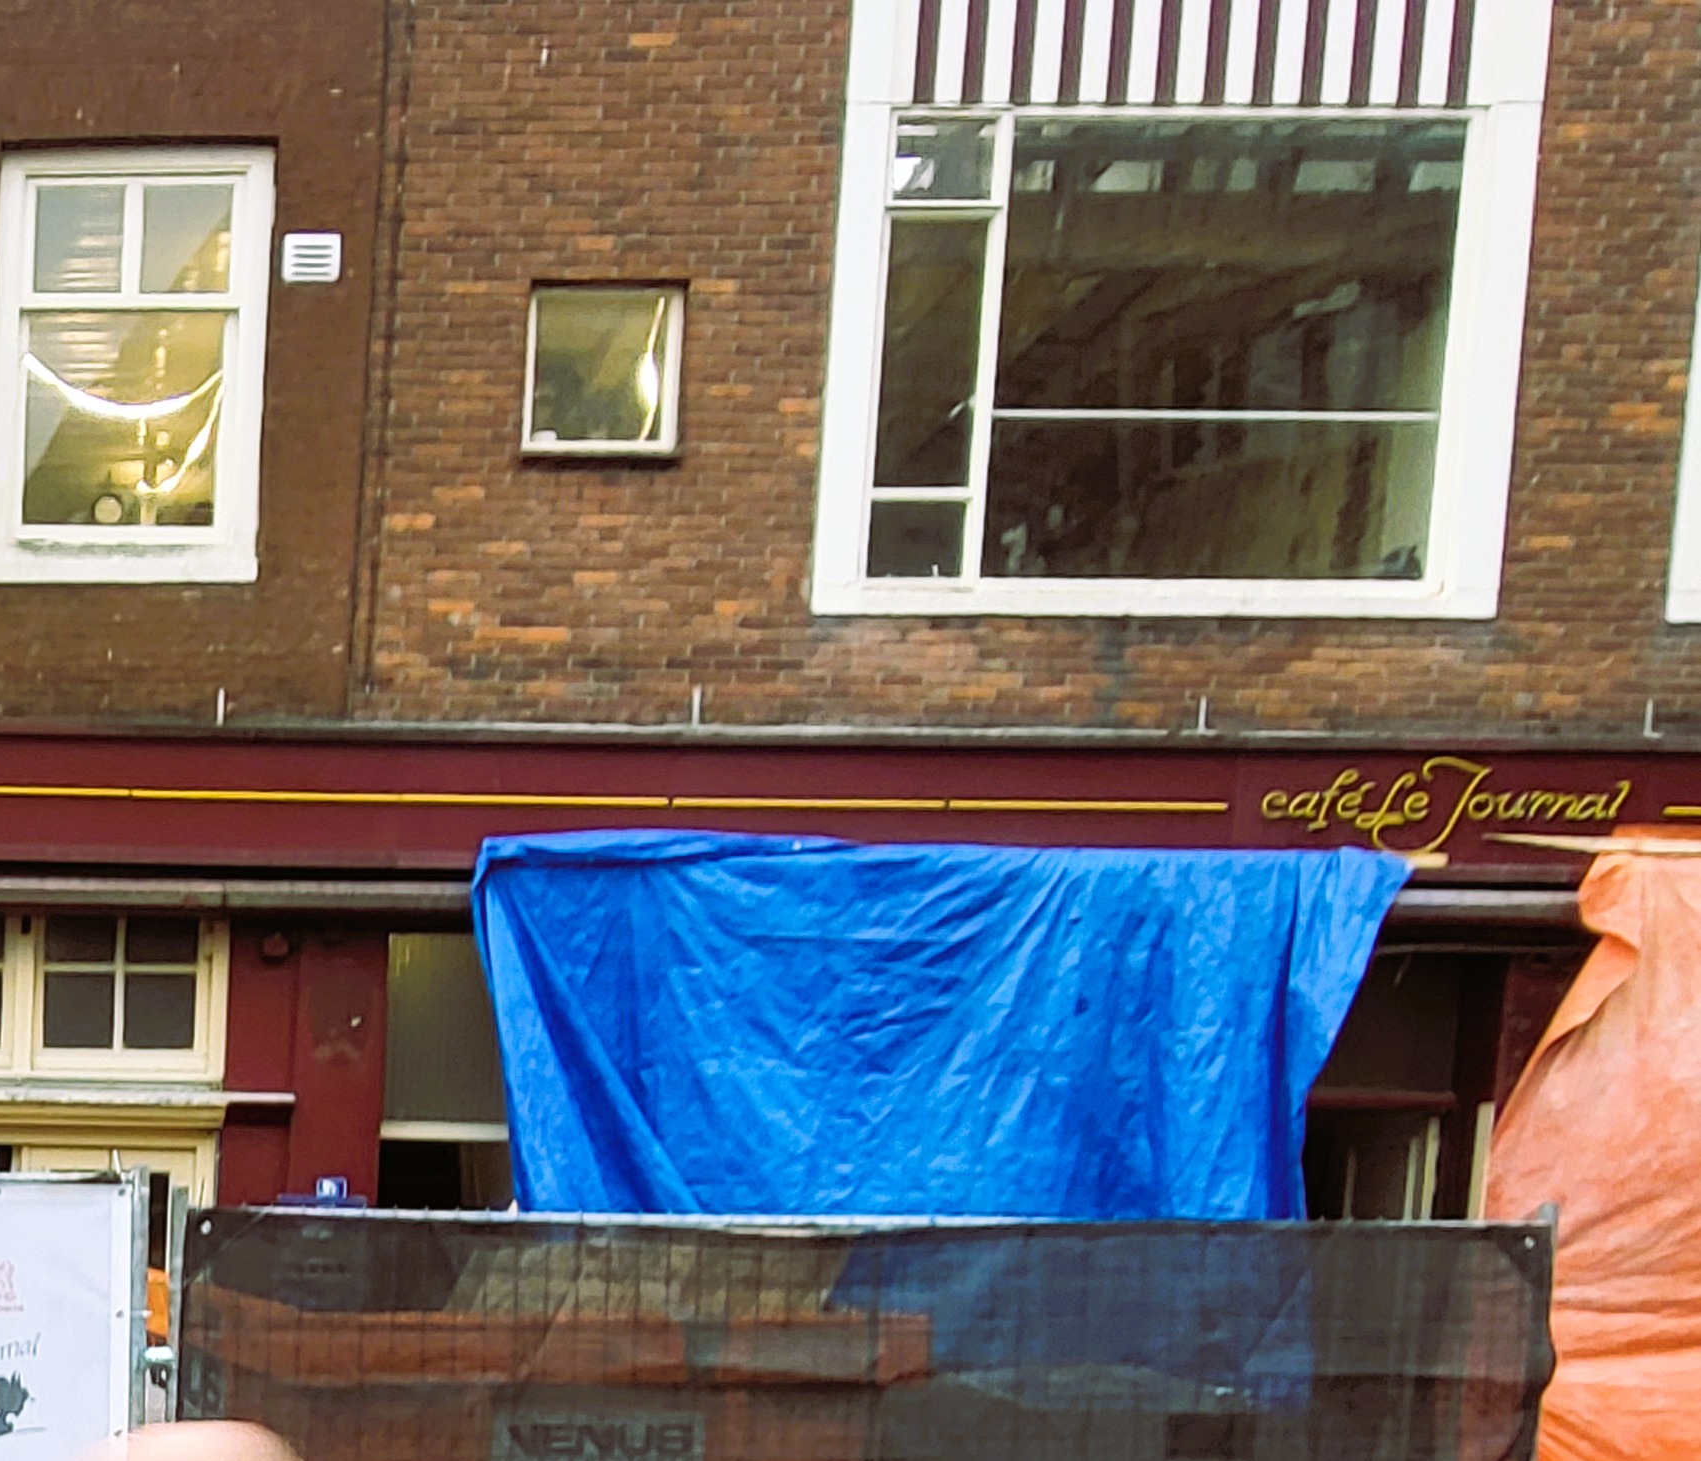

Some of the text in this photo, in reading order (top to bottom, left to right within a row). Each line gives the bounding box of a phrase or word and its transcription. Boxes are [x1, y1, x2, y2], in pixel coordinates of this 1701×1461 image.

[1260, 755, 1632, 854] café Le Journal
